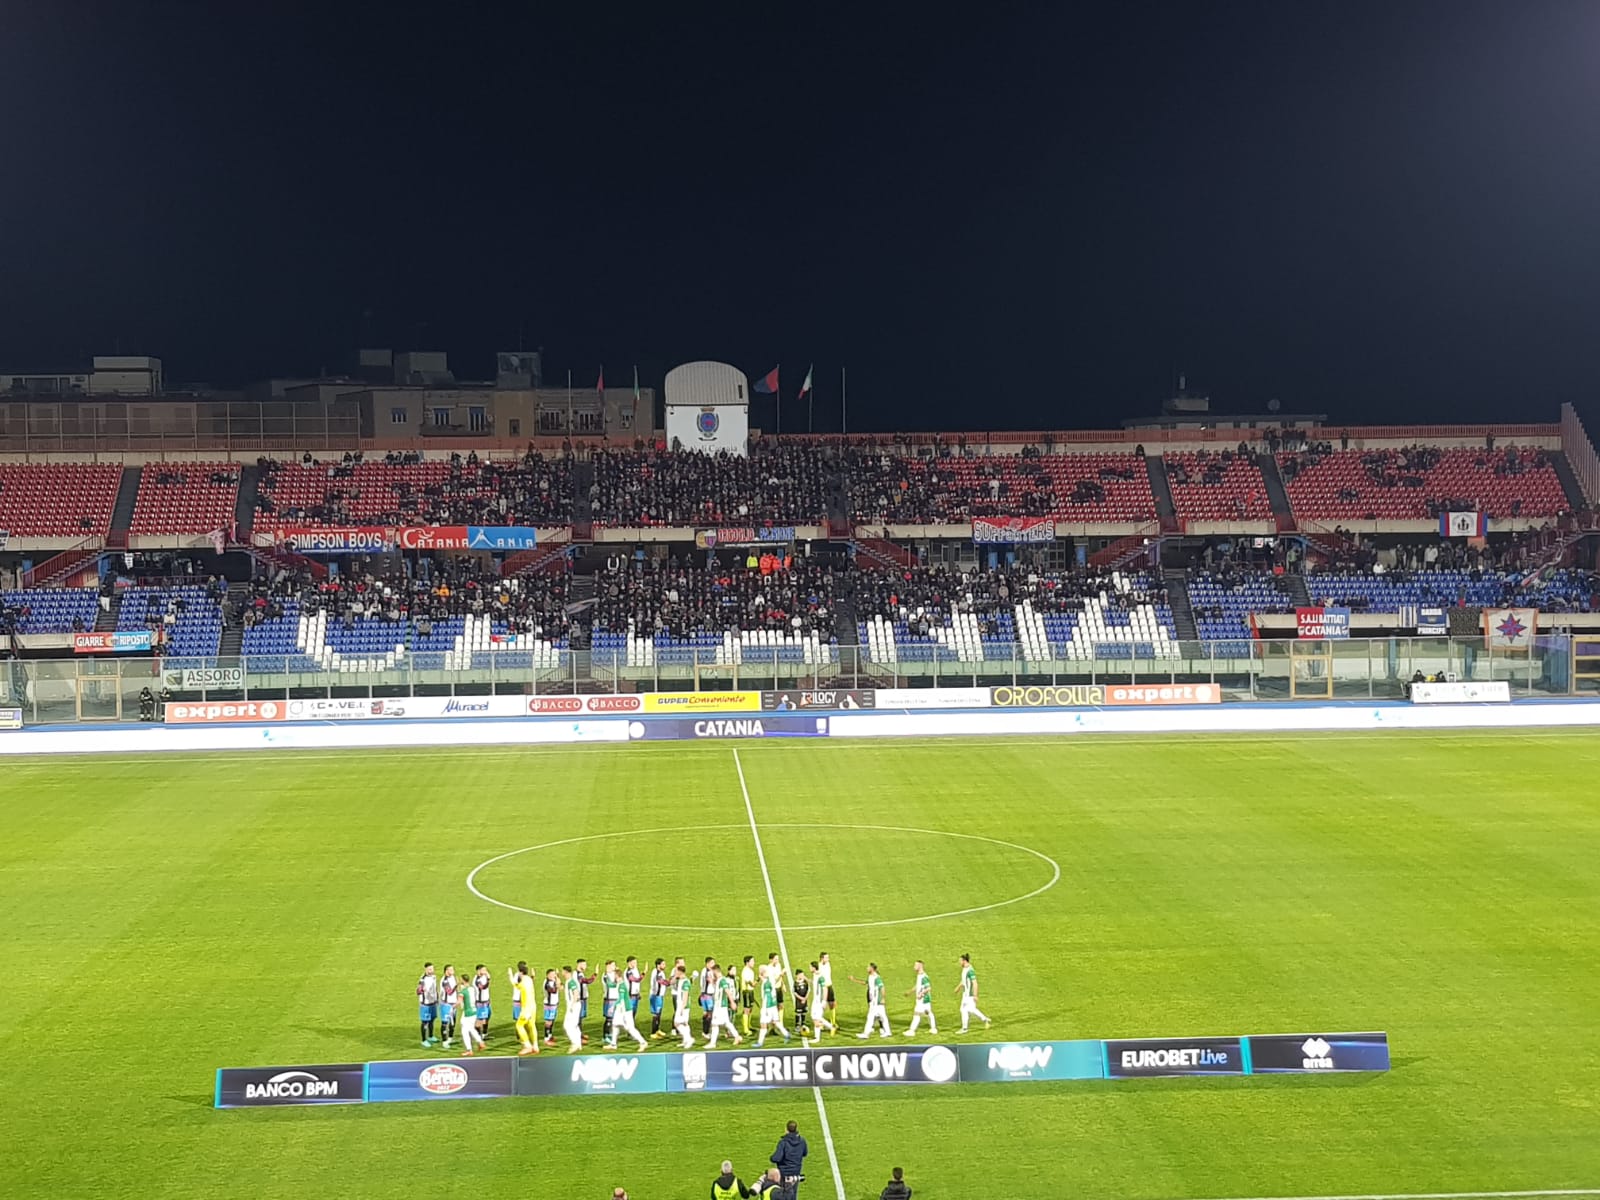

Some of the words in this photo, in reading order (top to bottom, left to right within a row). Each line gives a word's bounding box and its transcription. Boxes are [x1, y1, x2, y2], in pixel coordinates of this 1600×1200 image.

[290, 533, 344, 550] SIMPSON
[348, 532, 382, 548] BOYS
[402, 528, 469, 549] CATANIA
[717, 527, 755, 543] ORGOGLIO
[1304, 625, 1342, 636] CATANIA
[76, 635, 104, 647] GIARRE
[118, 633, 149, 645] RIPOSTO
[187, 669, 241, 682] ASSORO
[800, 691, 837, 706] TRILOGY
[1113, 686, 1193, 703] expert
[173, 703, 257, 720] expert
[694, 719, 764, 737] CATANIA
[987, 1044, 1053, 1071] NOW
[570, 1056, 639, 1083] NOW
[731, 1056, 808, 1082] SERIE
[815, 1054, 834, 1080] C
[840, 1052, 908, 1079] NOW
[246, 1083, 304, 1098] BANCO
[305, 1081, 338, 1096] BPM
